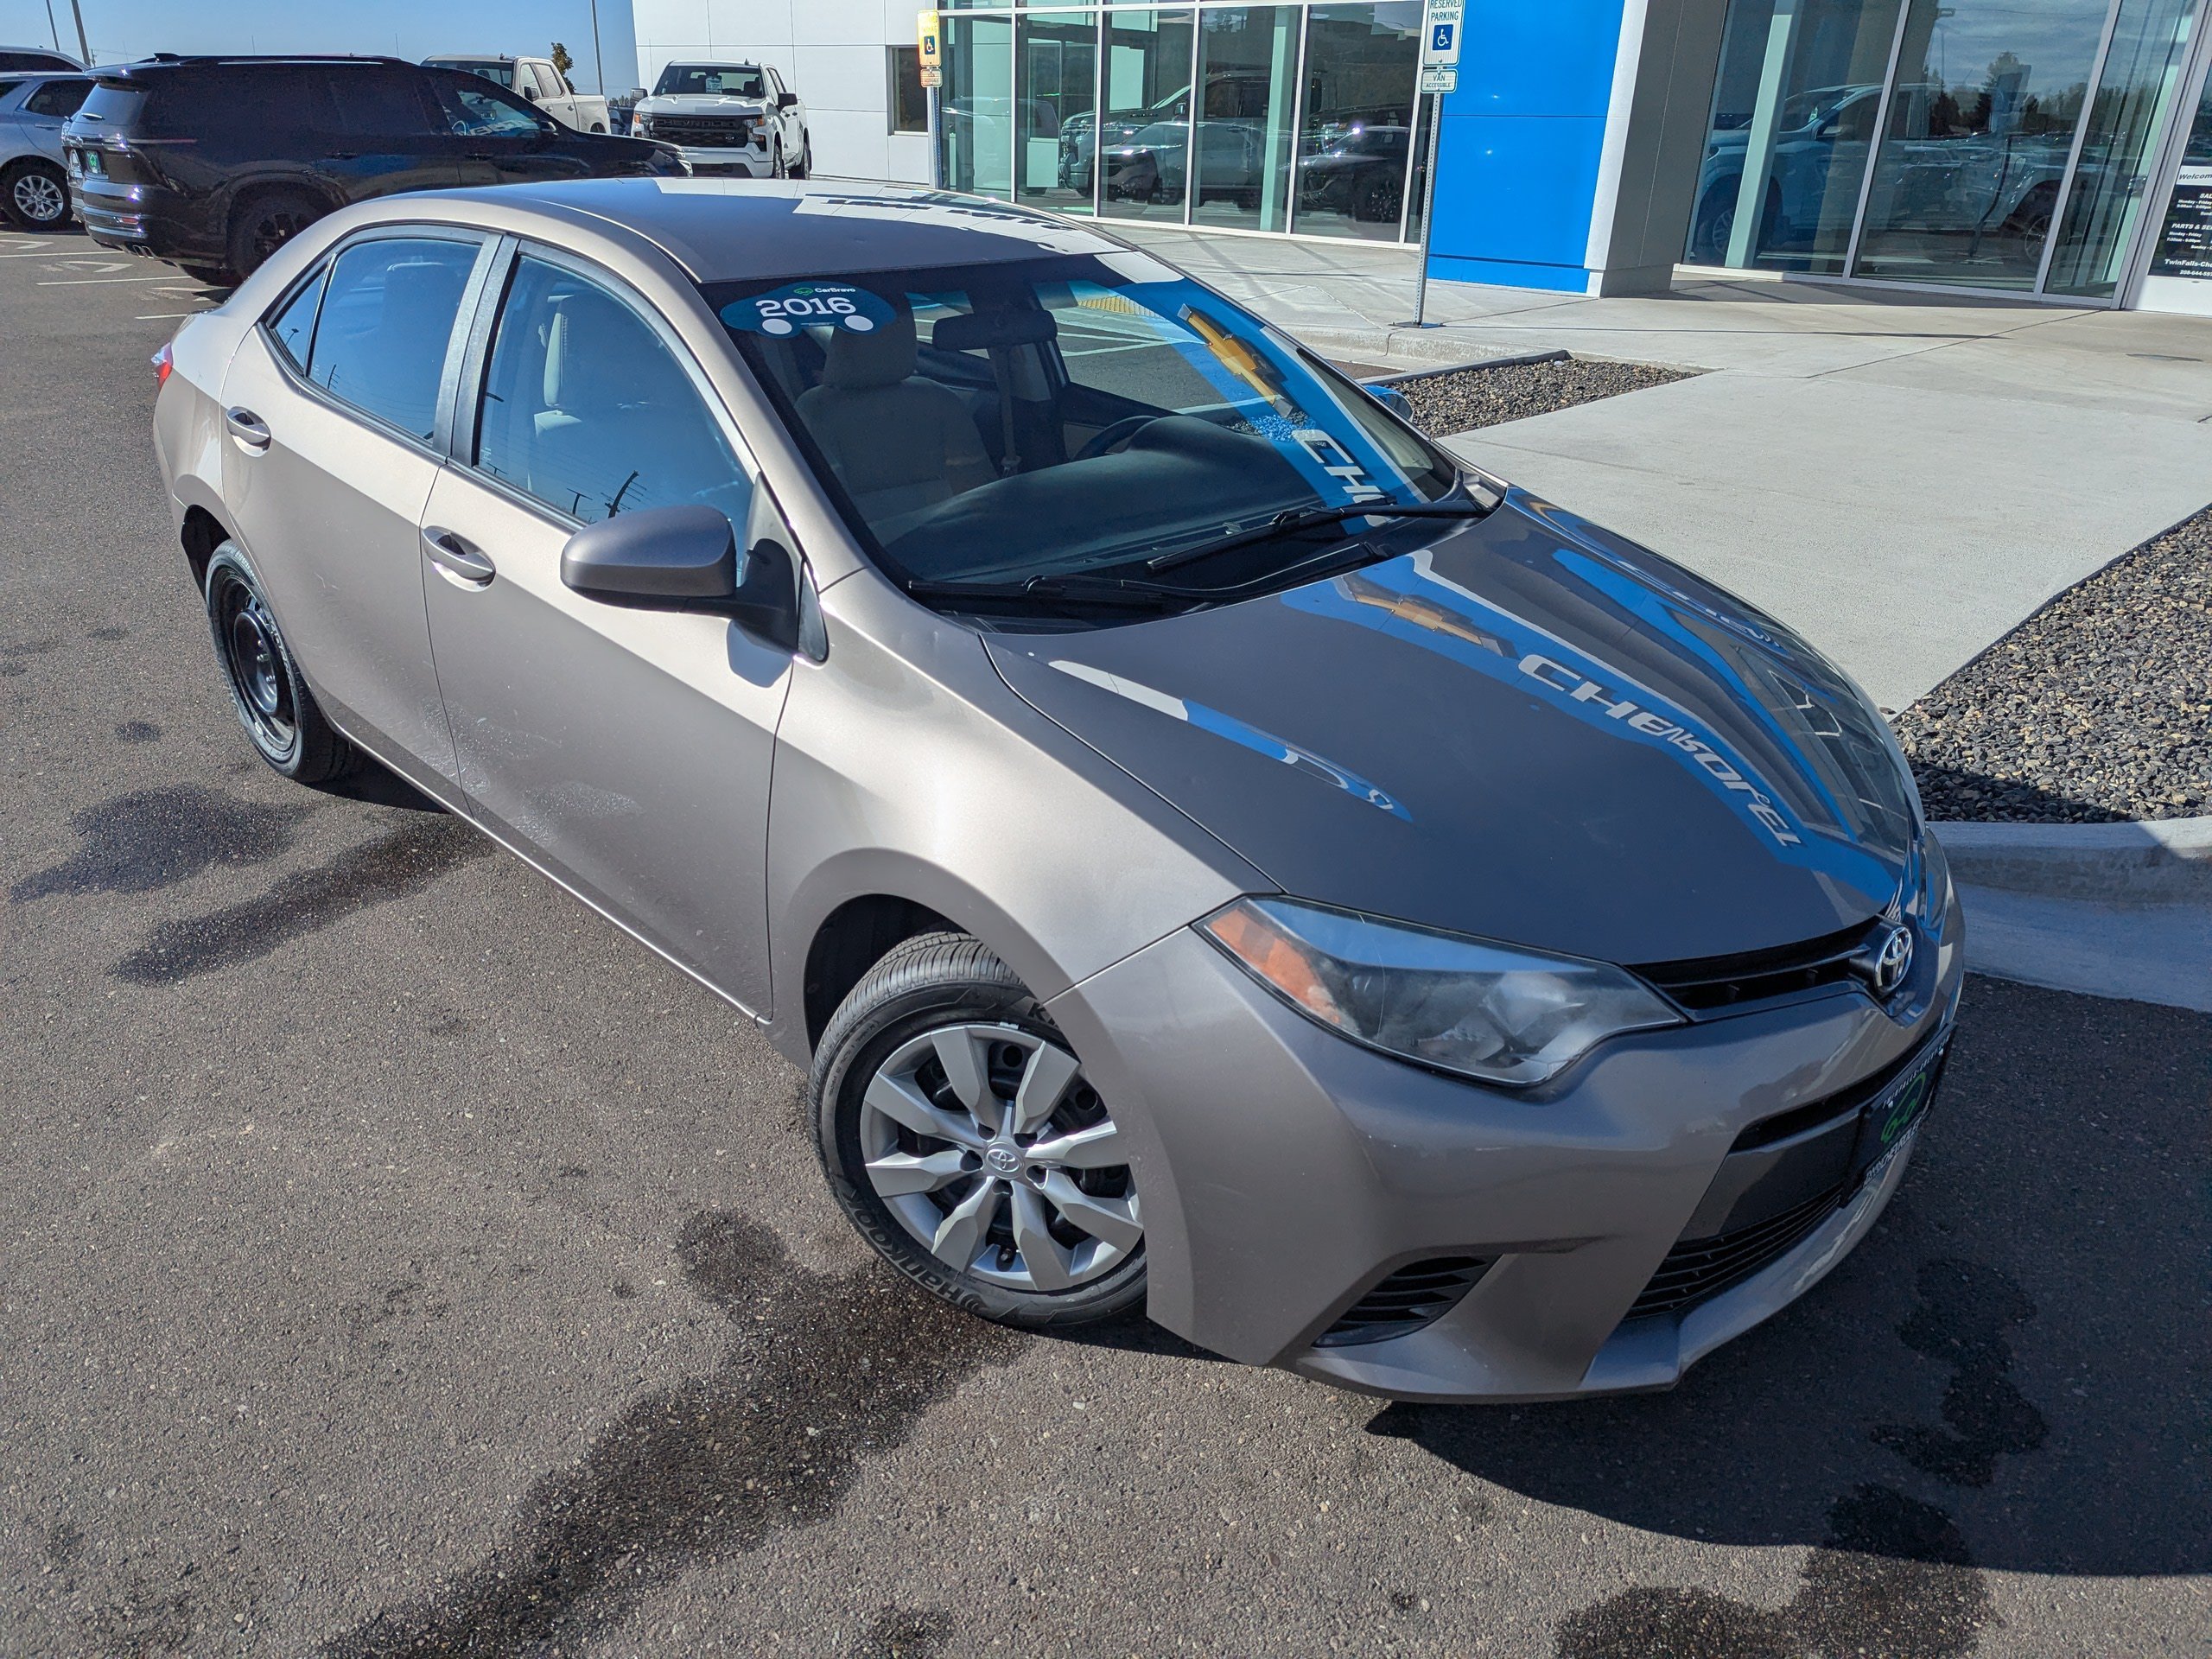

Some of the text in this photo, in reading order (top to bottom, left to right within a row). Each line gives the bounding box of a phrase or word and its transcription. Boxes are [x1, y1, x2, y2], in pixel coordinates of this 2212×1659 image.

[1430, 0, 1462, 9] RESERVED
[1431, 10, 1459, 22] PARKING
[755, 296, 856, 317] 2016
[844, 1189, 965, 1303] Hankook
